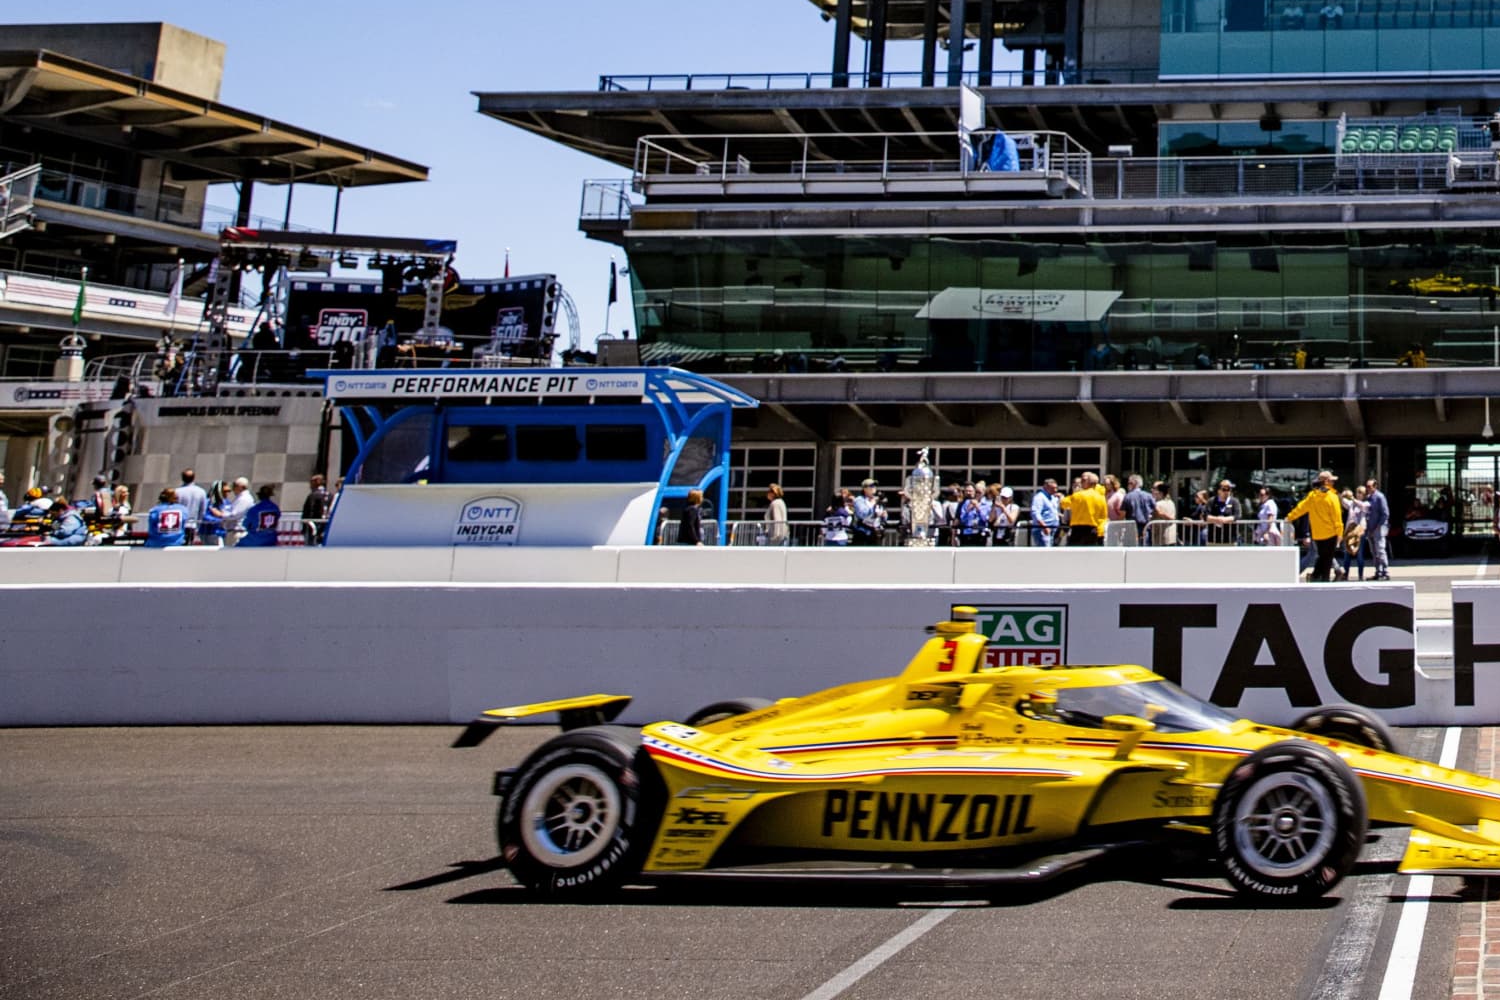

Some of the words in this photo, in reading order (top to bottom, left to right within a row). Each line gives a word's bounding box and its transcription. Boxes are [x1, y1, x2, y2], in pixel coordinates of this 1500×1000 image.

[328, 316, 358, 326] INDY
[316, 327, 367, 347] 500
[392, 377, 541, 394] PERFORMANCE
[546, 376, 579, 392] PIT
[484, 507, 513, 518] NTT
[457, 525, 514, 535] INDYCAR
[936, 640, 959, 672] 3
[822, 788, 1038, 841] PENNZOIL
